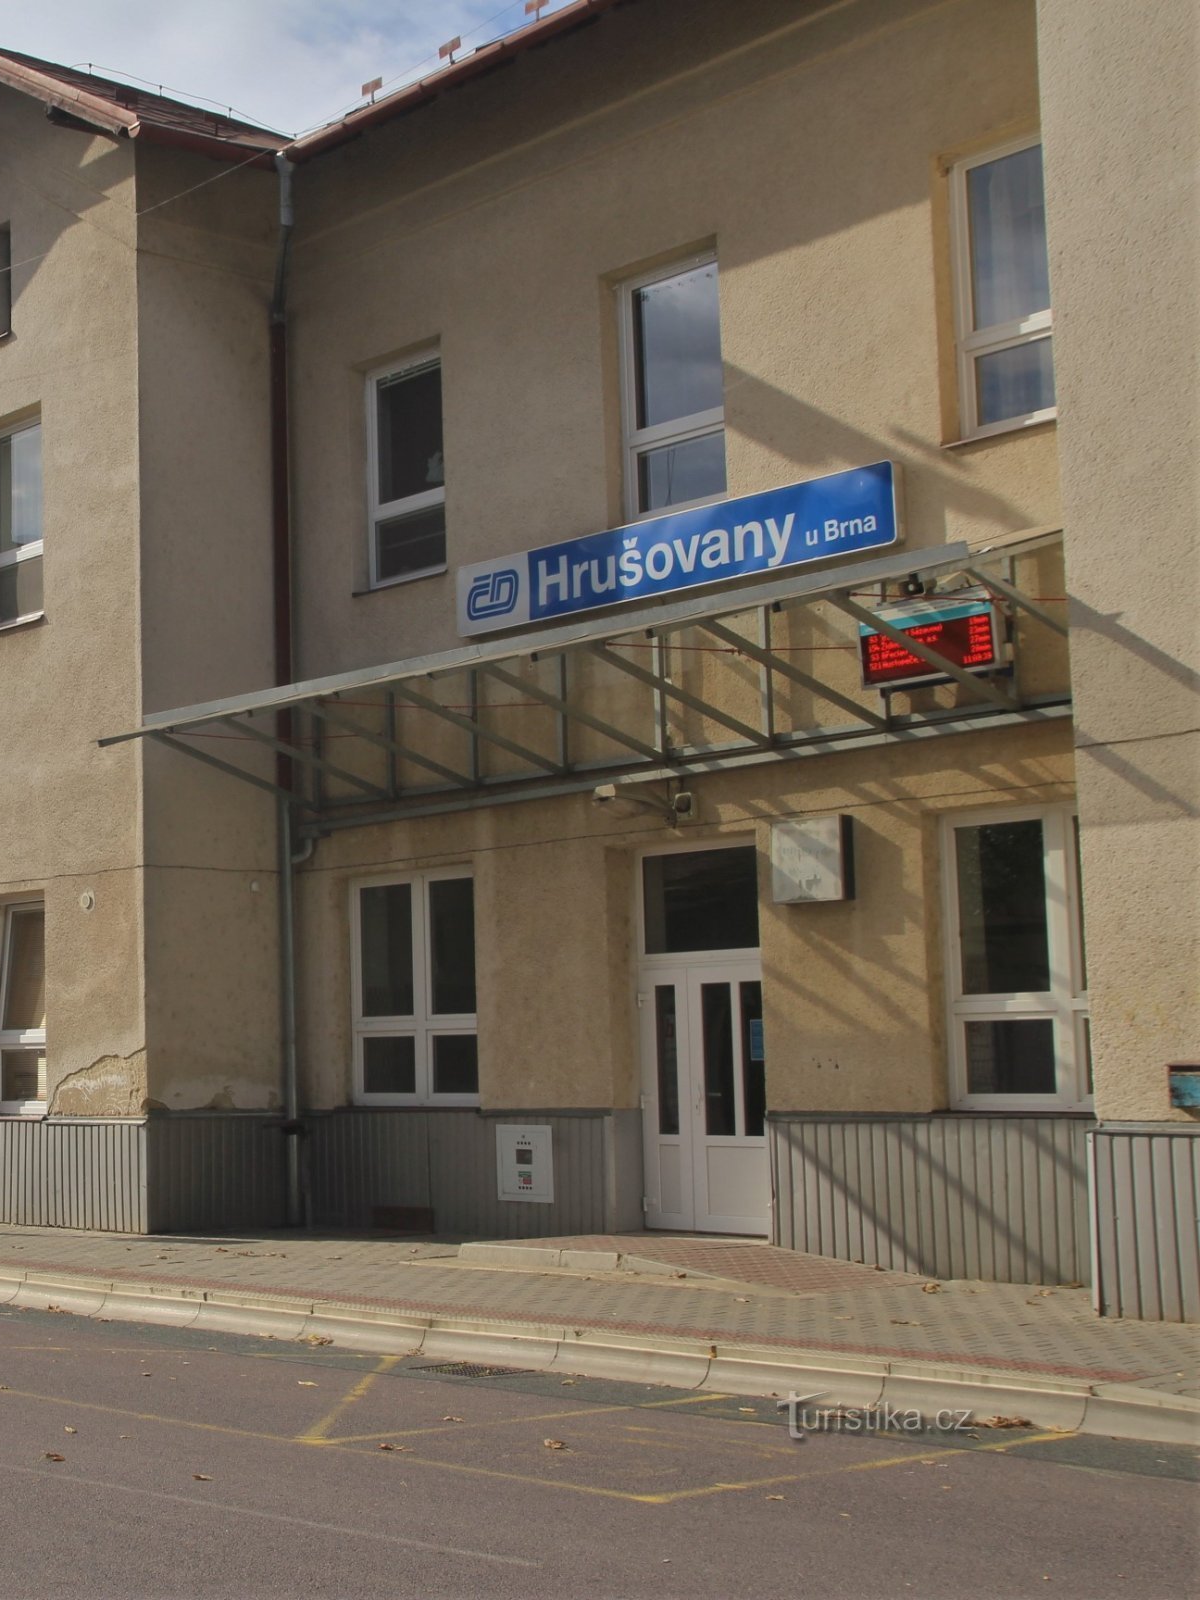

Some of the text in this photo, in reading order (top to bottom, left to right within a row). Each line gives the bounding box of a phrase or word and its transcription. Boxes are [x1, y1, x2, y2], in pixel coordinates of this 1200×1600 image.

[536, 512, 877, 606] Hrušovany u Brna
